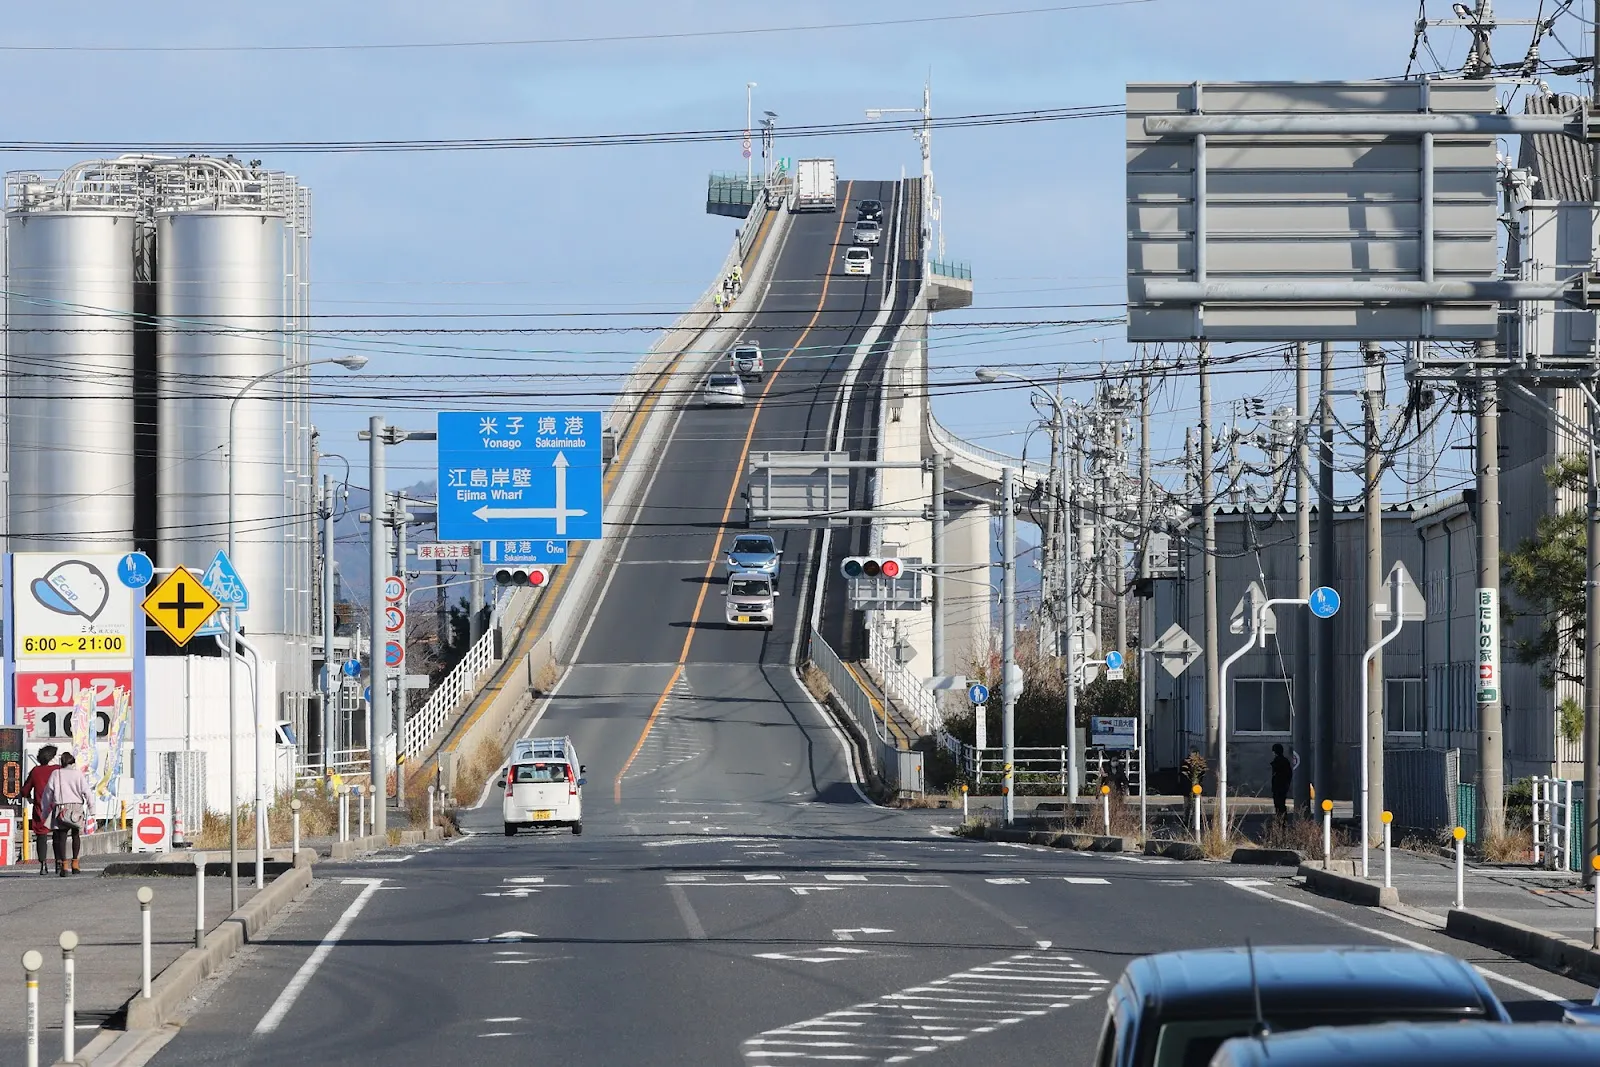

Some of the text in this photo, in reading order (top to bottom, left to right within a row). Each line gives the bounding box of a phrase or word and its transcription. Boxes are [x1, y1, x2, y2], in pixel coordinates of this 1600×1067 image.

[479, 416, 584, 436] 米子 境港
[482, 437, 586, 450] Yonago Sakaiminato
[448, 468, 532, 488] 江島岸壁
[456, 490, 523, 502] Ejima Wharf
[420, 546, 472, 558] 凍結注意
[504, 541, 532, 553] 境港
[504, 554, 537, 562] Sakaiminato
[386, 583, 400, 595] 40
[25, 638, 57, 651] 6:00
[78, 637, 122, 650] 21:00
[32, 678, 116, 704] セルフ
[138, 802, 165, 815] 出口
